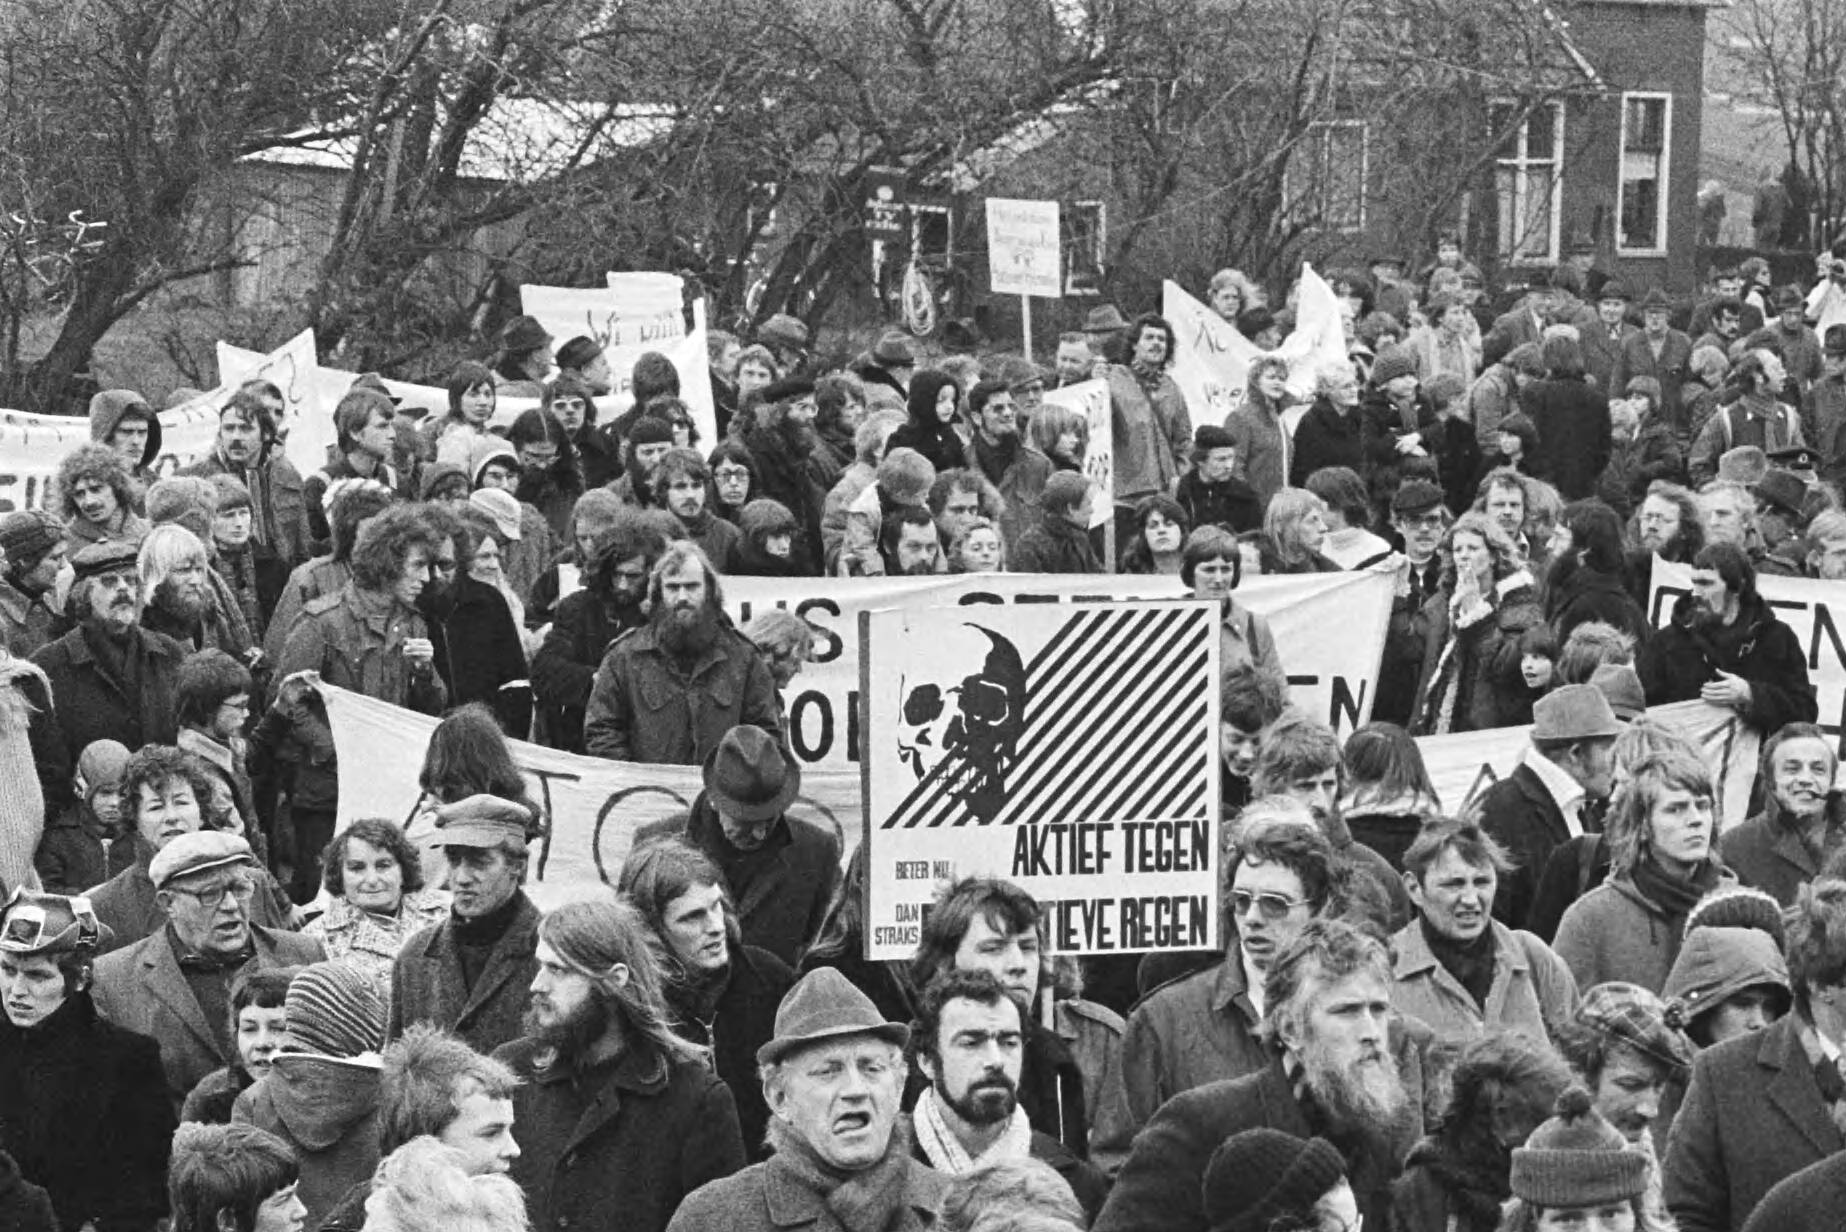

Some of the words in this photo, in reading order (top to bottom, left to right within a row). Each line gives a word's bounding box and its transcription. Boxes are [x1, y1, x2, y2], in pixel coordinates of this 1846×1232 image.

[1012, 823, 1115, 877] AKTIEF
[1120, 820, 1210, 873] TEGEN
[895, 860, 930, 881] BETER
[895, 904, 920, 924] DAN
[1120, 895, 1209, 950] REGEN
[874, 926, 920, 947] STRAKS
